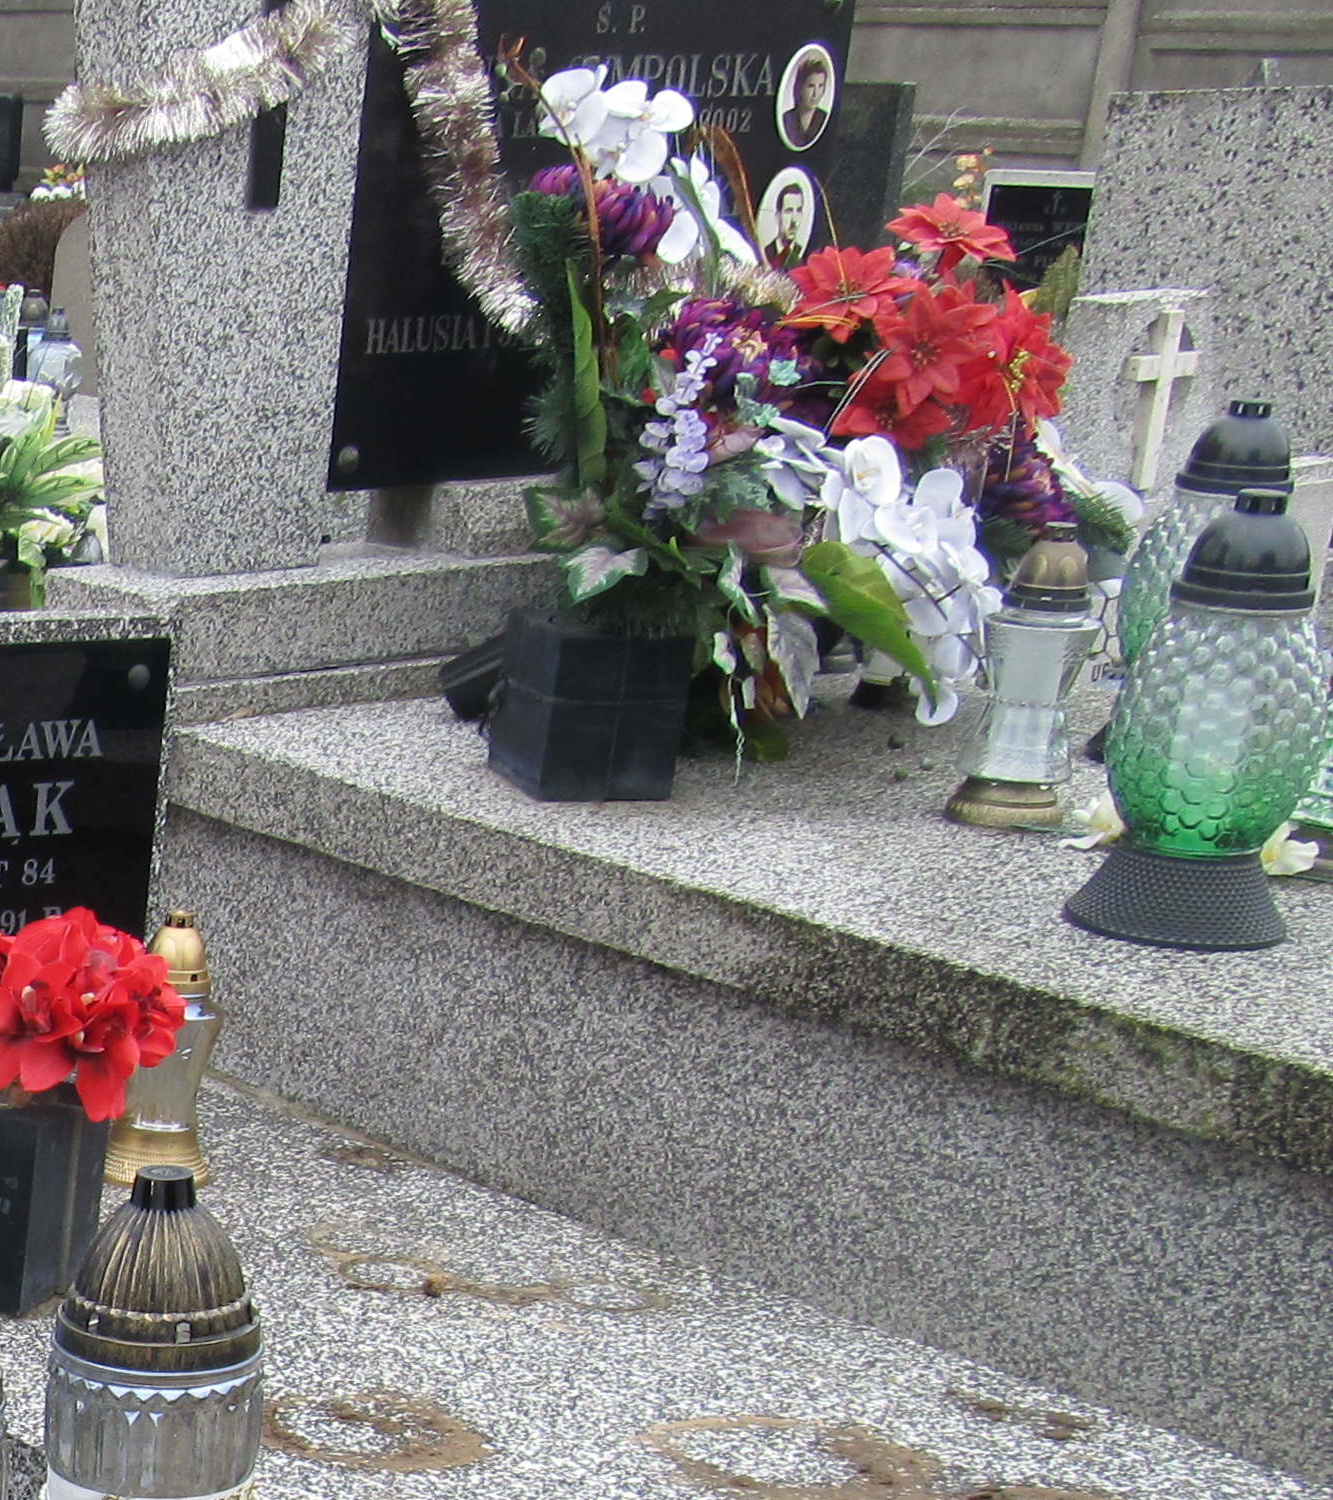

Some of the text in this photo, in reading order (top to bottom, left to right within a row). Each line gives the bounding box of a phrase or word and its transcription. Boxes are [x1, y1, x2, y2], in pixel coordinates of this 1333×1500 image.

[630, 4, 647, 33] P.
[365, 315, 479, 354] HALUSIA
[21, 857, 57, 886] 84
